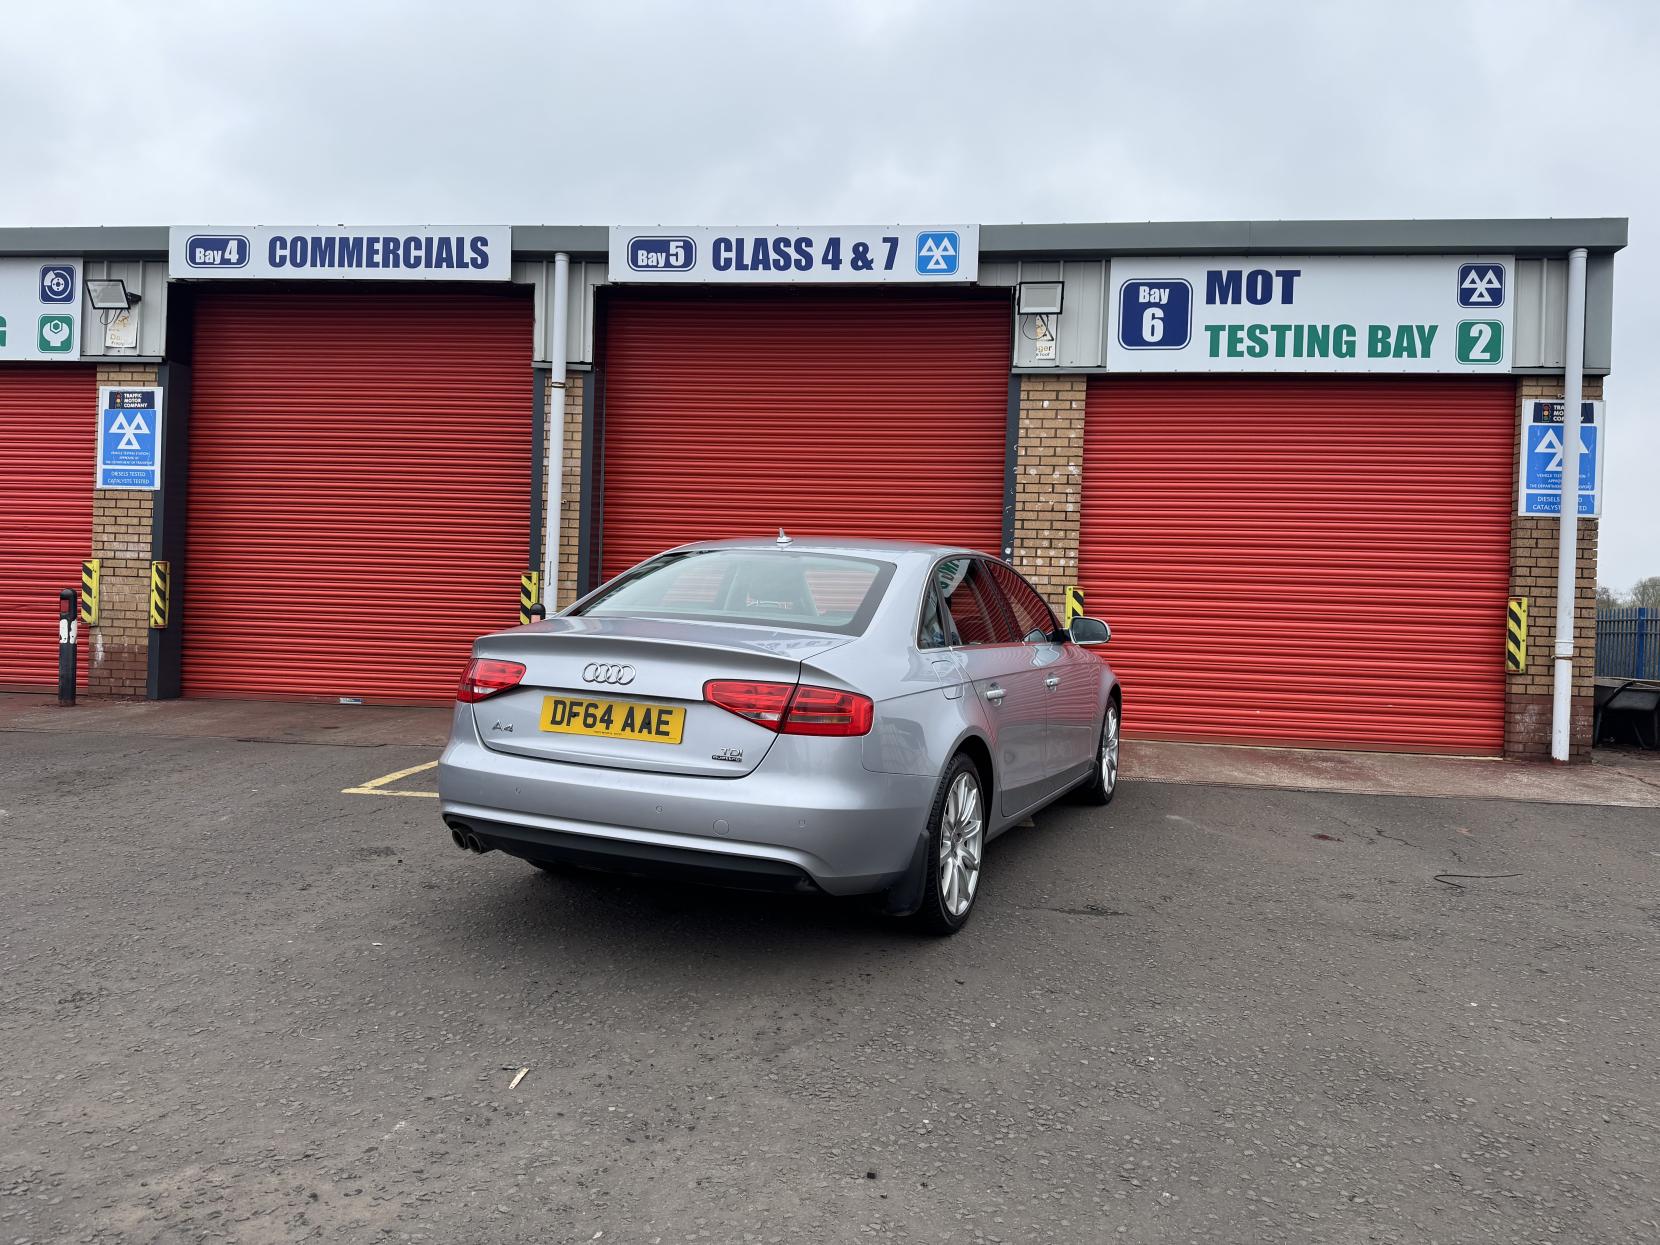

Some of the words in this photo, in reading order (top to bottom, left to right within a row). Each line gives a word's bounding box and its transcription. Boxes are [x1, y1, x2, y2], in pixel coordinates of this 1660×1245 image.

[195, 247, 222, 264] Bay
[224, 240, 239, 263] 4
[268, 236, 489, 270] COMMERCIALS
[637, 250, 665, 268] Bay
[669, 241, 685, 266] 5
[712, 237, 814, 271] CLASS
[821, 237, 842, 271] 4
[850, 241, 874, 271] &
[882, 237, 899, 270] 7
[1139, 286, 1169, 305] Bay
[1205, 269, 1301, 305] MOT
[1142, 307, 1164, 342] 6
[1204, 324, 1357, 359] TESTING
[1367, 324, 1439, 359] BAY
[1468, 322, 1492, 360] 2
[491, 719, 514, 733] A4
[550, 699, 614, 731] DF64
[621, 705, 673, 737] AAE
[720, 747, 744, 758] TDI
